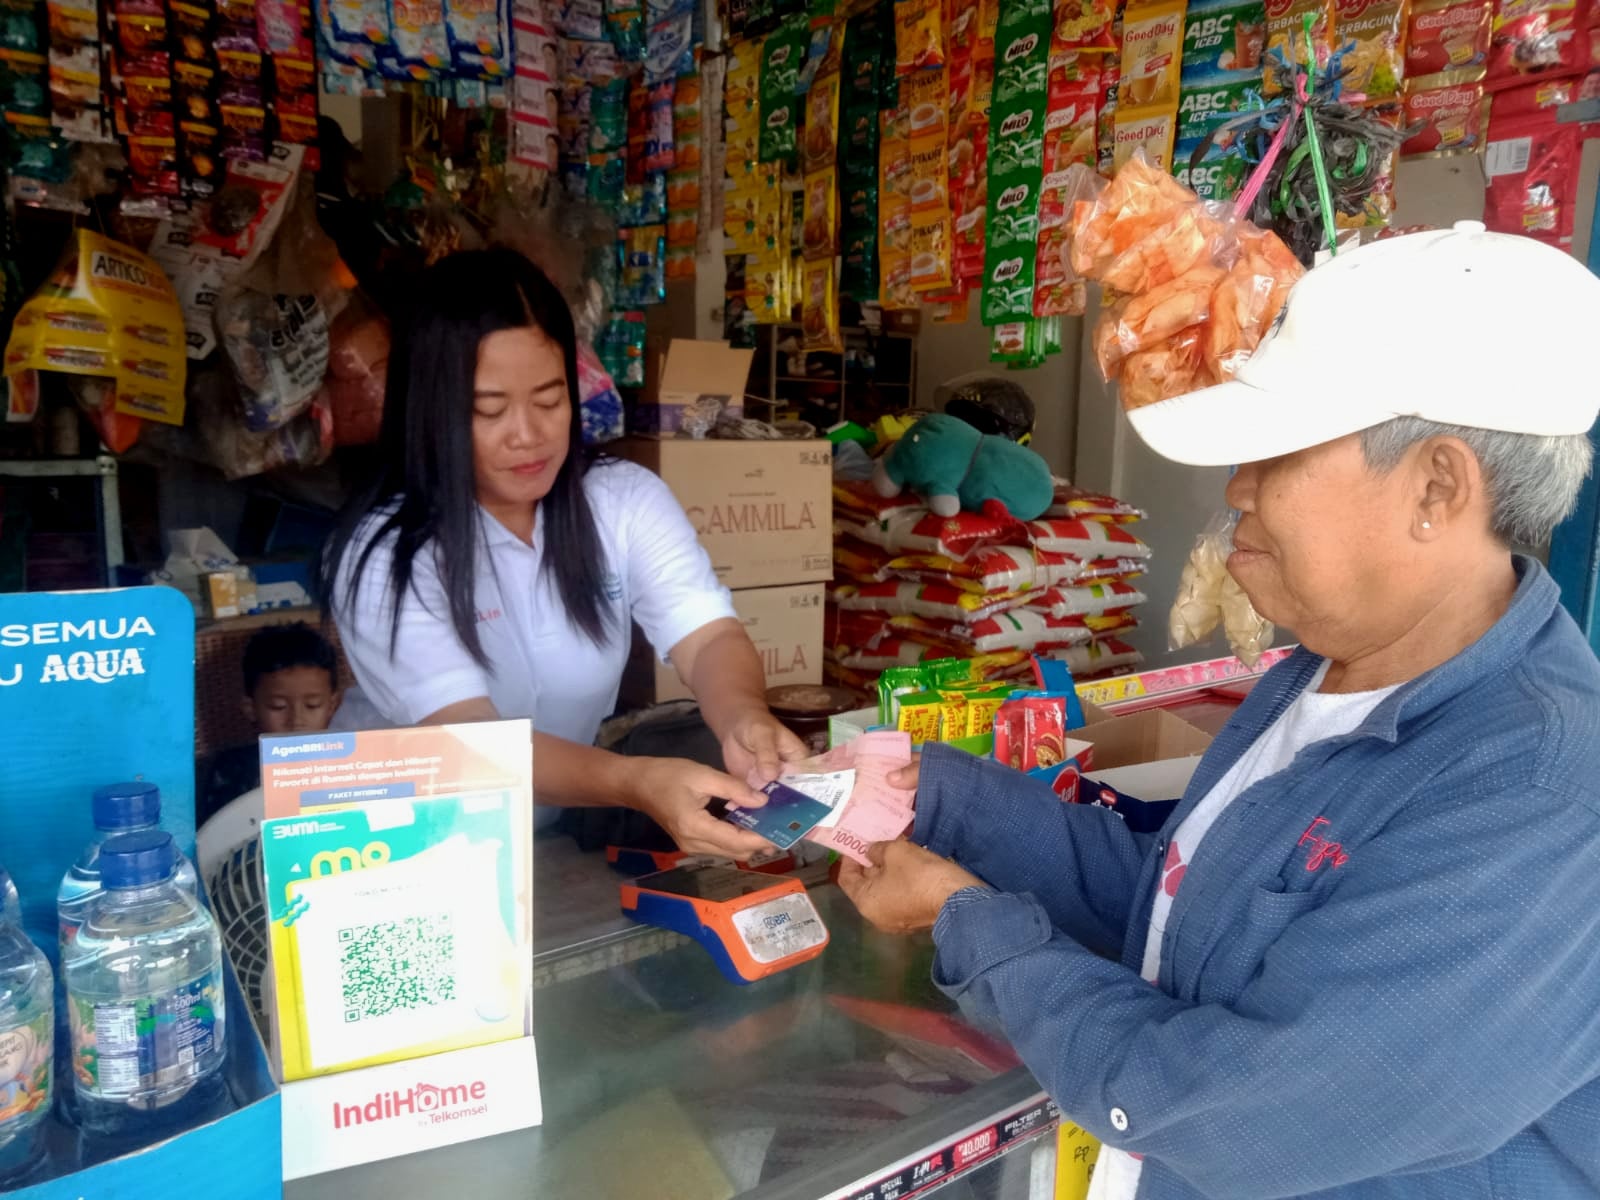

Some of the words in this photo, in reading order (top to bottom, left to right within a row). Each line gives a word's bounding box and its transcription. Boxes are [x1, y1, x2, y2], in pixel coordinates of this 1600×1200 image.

[1185, 14, 1233, 40] ABC
[1416, 12, 1452, 29] Good
[1453, 7, 1482, 24] Day
[1126, 27, 1154, 42] Good
[1155, 23, 1175, 36] Day
[1194, 35, 1223, 49] ICED
[1008, 40, 1035, 57] MILO
[1179, 90, 1229, 113] ABC
[1410, 95, 1446, 109] Good
[1446, 90, 1474, 106] Day
[1003, 115, 1029, 131] MILO
[1117, 128, 1143, 142] Good
[1146, 126, 1164, 138] Day
[1176, 166, 1223, 186] ABC
[1000, 190, 1025, 205] MILO
[996, 263, 1020, 277] MILO
[0, 616, 156, 647] SEMUA
[40, 647, 146, 684] AQUA
[333, 1080, 486, 1129] IndiHome
[429, 1104, 488, 1125] Telkomsel
[1005, 1109, 1042, 1133] FILTER
